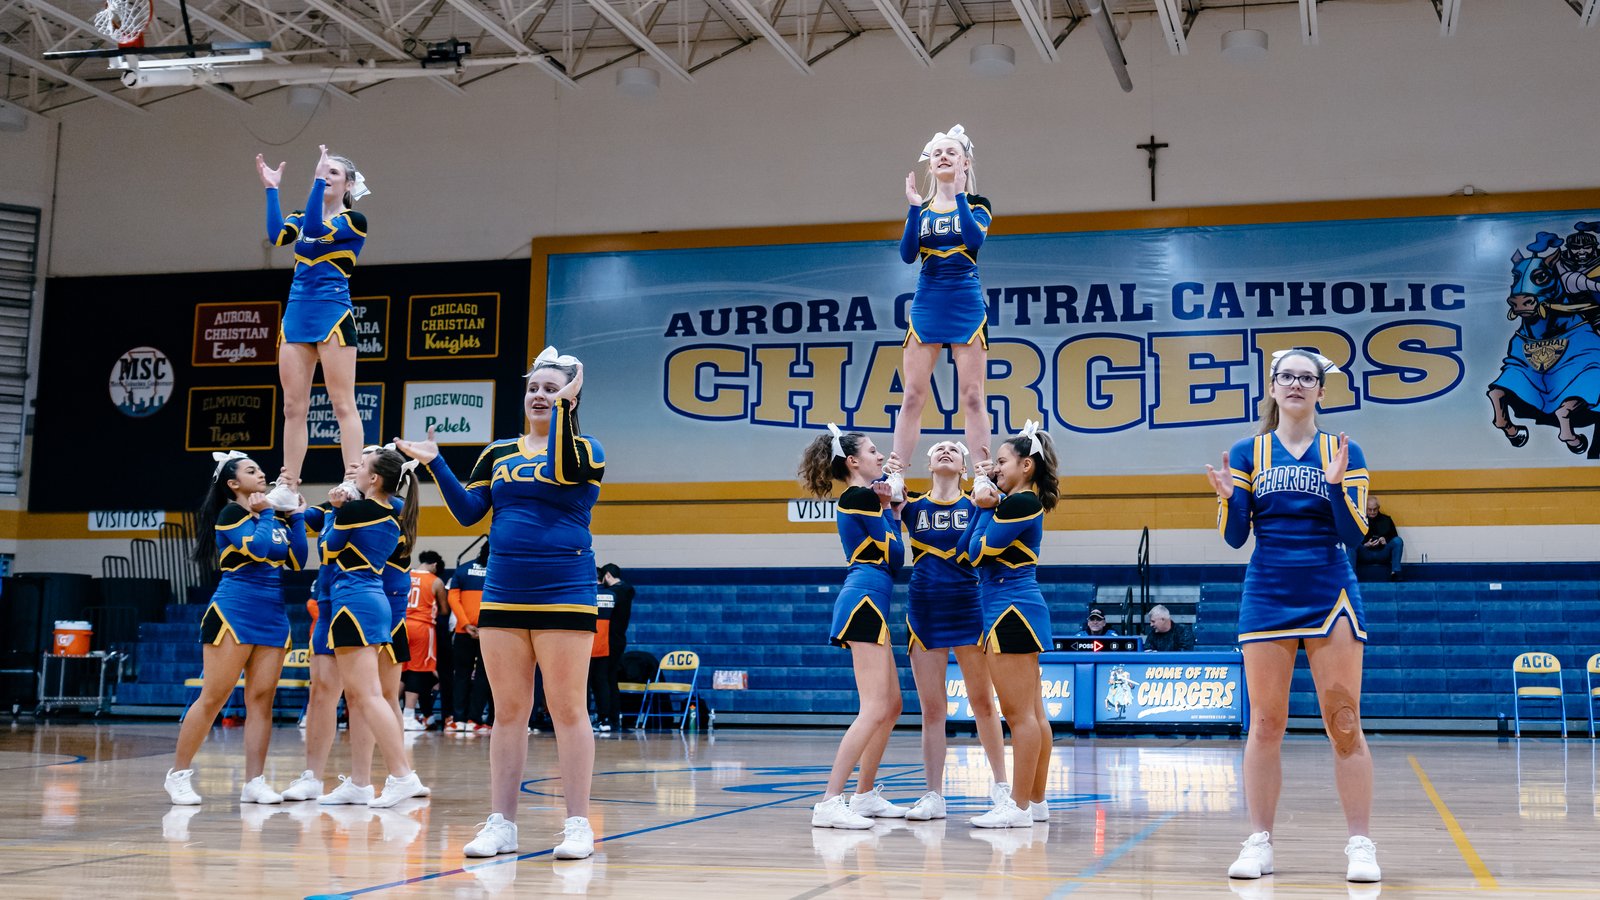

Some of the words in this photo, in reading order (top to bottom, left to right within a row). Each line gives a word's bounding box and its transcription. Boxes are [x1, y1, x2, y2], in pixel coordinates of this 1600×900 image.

[430, 303, 478, 317] CHICAGO
[664, 296, 877, 337] AURORA
[894, 283, 1153, 330] CTRAL
[1171, 281, 1465, 320] CATHOLIC
[214, 310, 261, 326] AURORA
[421, 318, 486, 332] CHRISTIAN
[205, 327, 269, 341] CHRISTIAN
[357, 337, 383, 353] rish
[424, 332, 481, 355] Knights
[1524, 339, 1565, 351] CENTRAL
[212, 342, 257, 363] Eagles
[119, 357, 166, 381] MSC
[664, 319, 1465, 435] CHARGERS
[202, 396, 261, 411] ELMWOOD
[413, 393, 484, 410] RIDGEWOOD
[215, 412, 246, 425] PARK
[425, 416, 471, 433] Rebels
[208, 426, 251, 447] Tigers
[309, 422, 341, 444] Knig
[1255, 465, 1331, 501] CHARGER
[795, 500, 838, 519] VISIT
[95, 510, 158, 529] VISITORS
[915, 509, 968, 532] ACC
[288, 651, 311, 664] AC
[667, 653, 693, 666] ACC
[1521, 655, 1552, 669] ACC
[1145, 666, 1183, 680] HOME
[1185, 666, 1203, 680] OF
[1204, 666, 1229, 679] THE
[1138, 681, 1236, 708] CHARGERS
